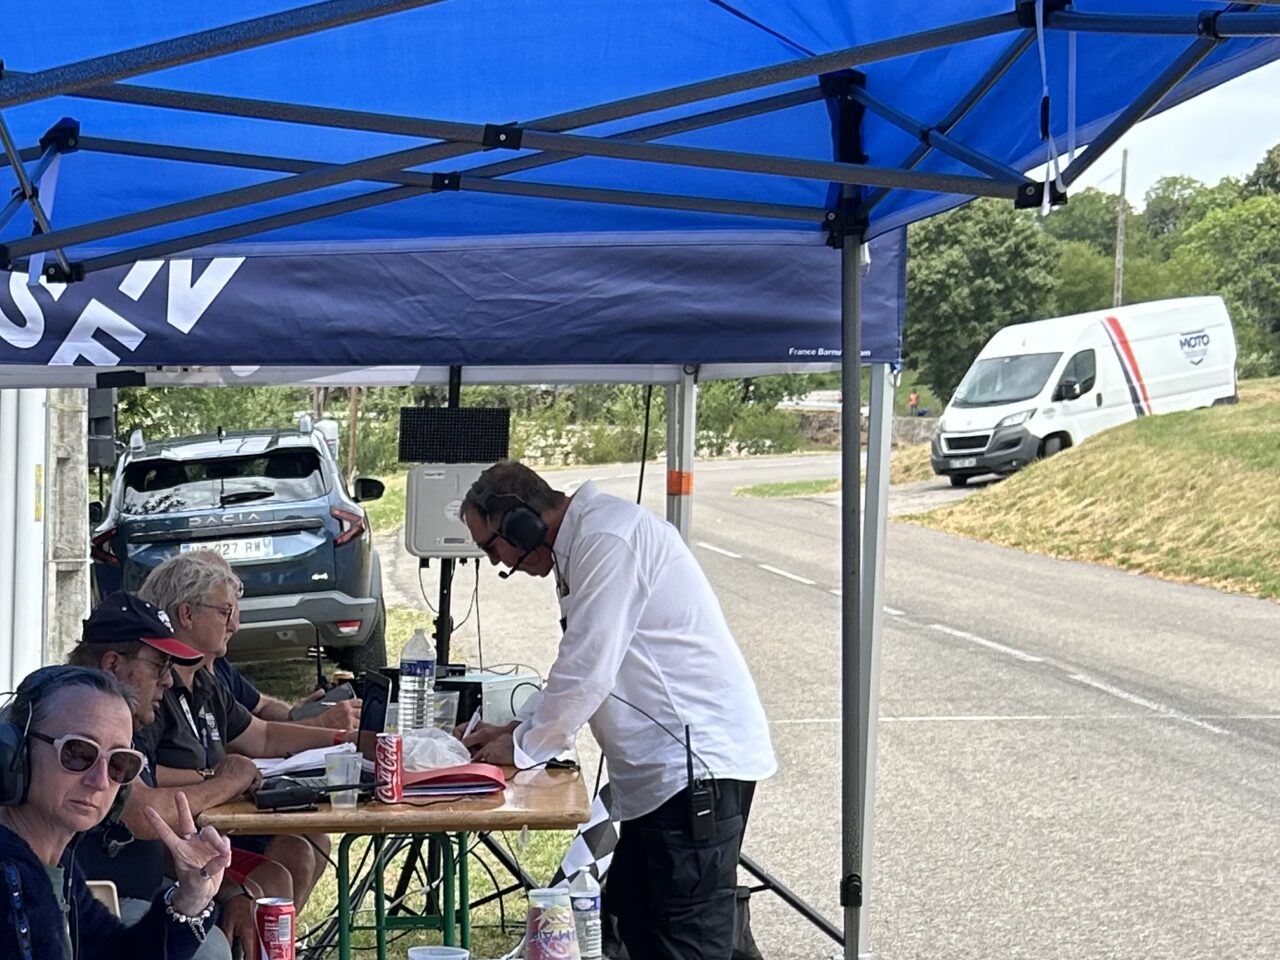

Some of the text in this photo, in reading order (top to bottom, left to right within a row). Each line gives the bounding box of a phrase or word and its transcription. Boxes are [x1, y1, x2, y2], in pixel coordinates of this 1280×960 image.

[1179, 334, 1210, 350] MOTO
[788, 347, 816, 356] France
[188, 512, 260, 526] DACIA
